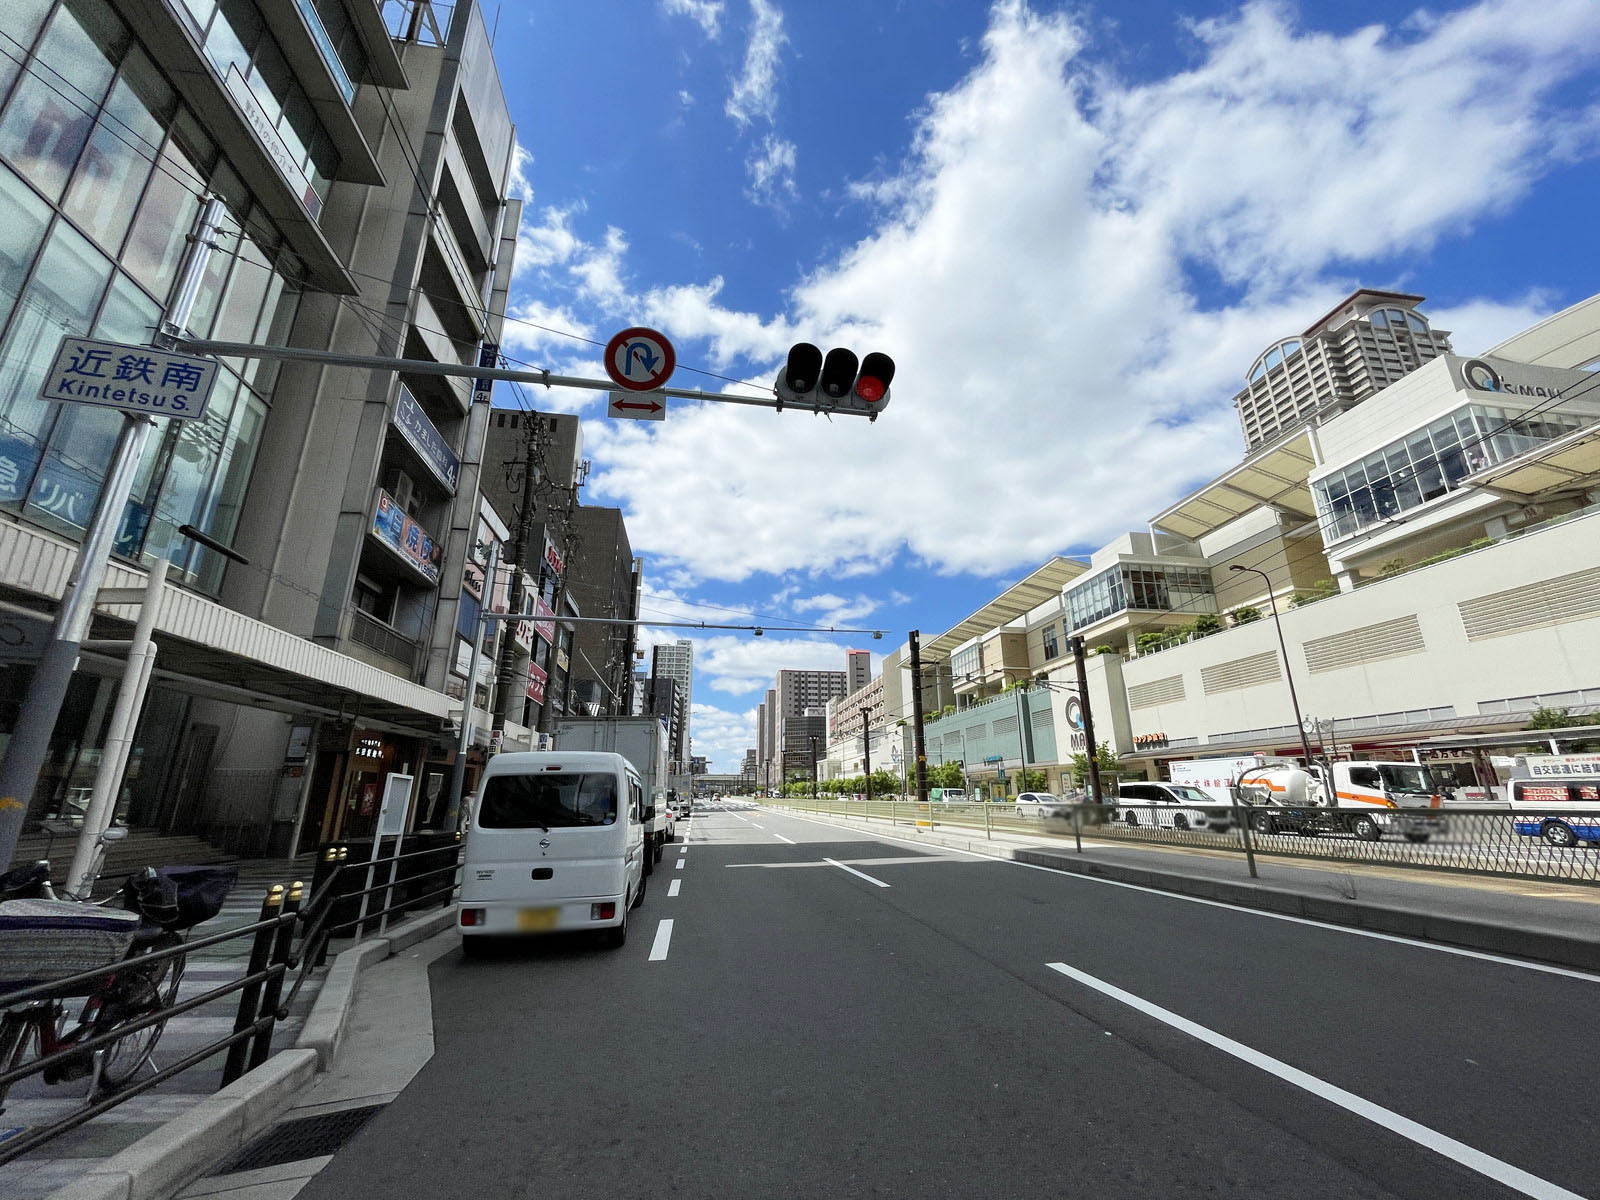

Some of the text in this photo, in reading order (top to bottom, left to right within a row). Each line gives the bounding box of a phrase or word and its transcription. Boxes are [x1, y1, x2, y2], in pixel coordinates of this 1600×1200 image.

[64, 346, 206, 393] 近鉄南
[57, 377, 190, 411] Kintetsu S.
